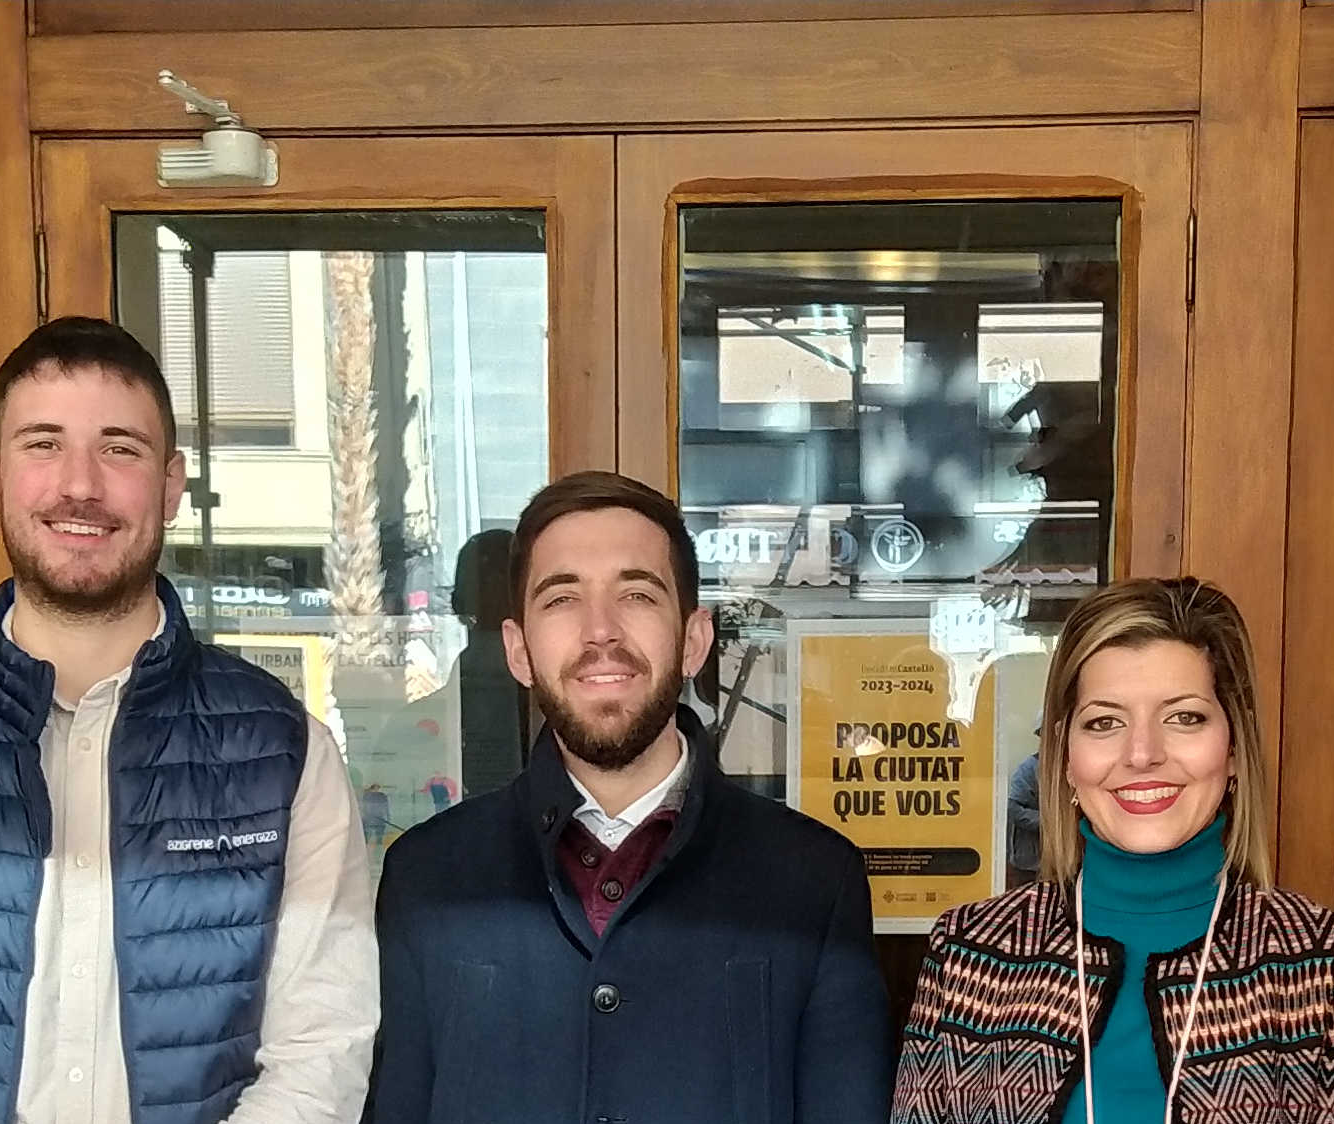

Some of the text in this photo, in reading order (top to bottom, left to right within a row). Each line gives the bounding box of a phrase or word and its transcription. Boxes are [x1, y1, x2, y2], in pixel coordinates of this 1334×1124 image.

[861, 680, 935, 694] 2023-2024
[836, 722, 960, 749] PROPOSA
[832, 756, 964, 782] LA CIUTAT
[833, 789, 961, 823] QUE VOLS
